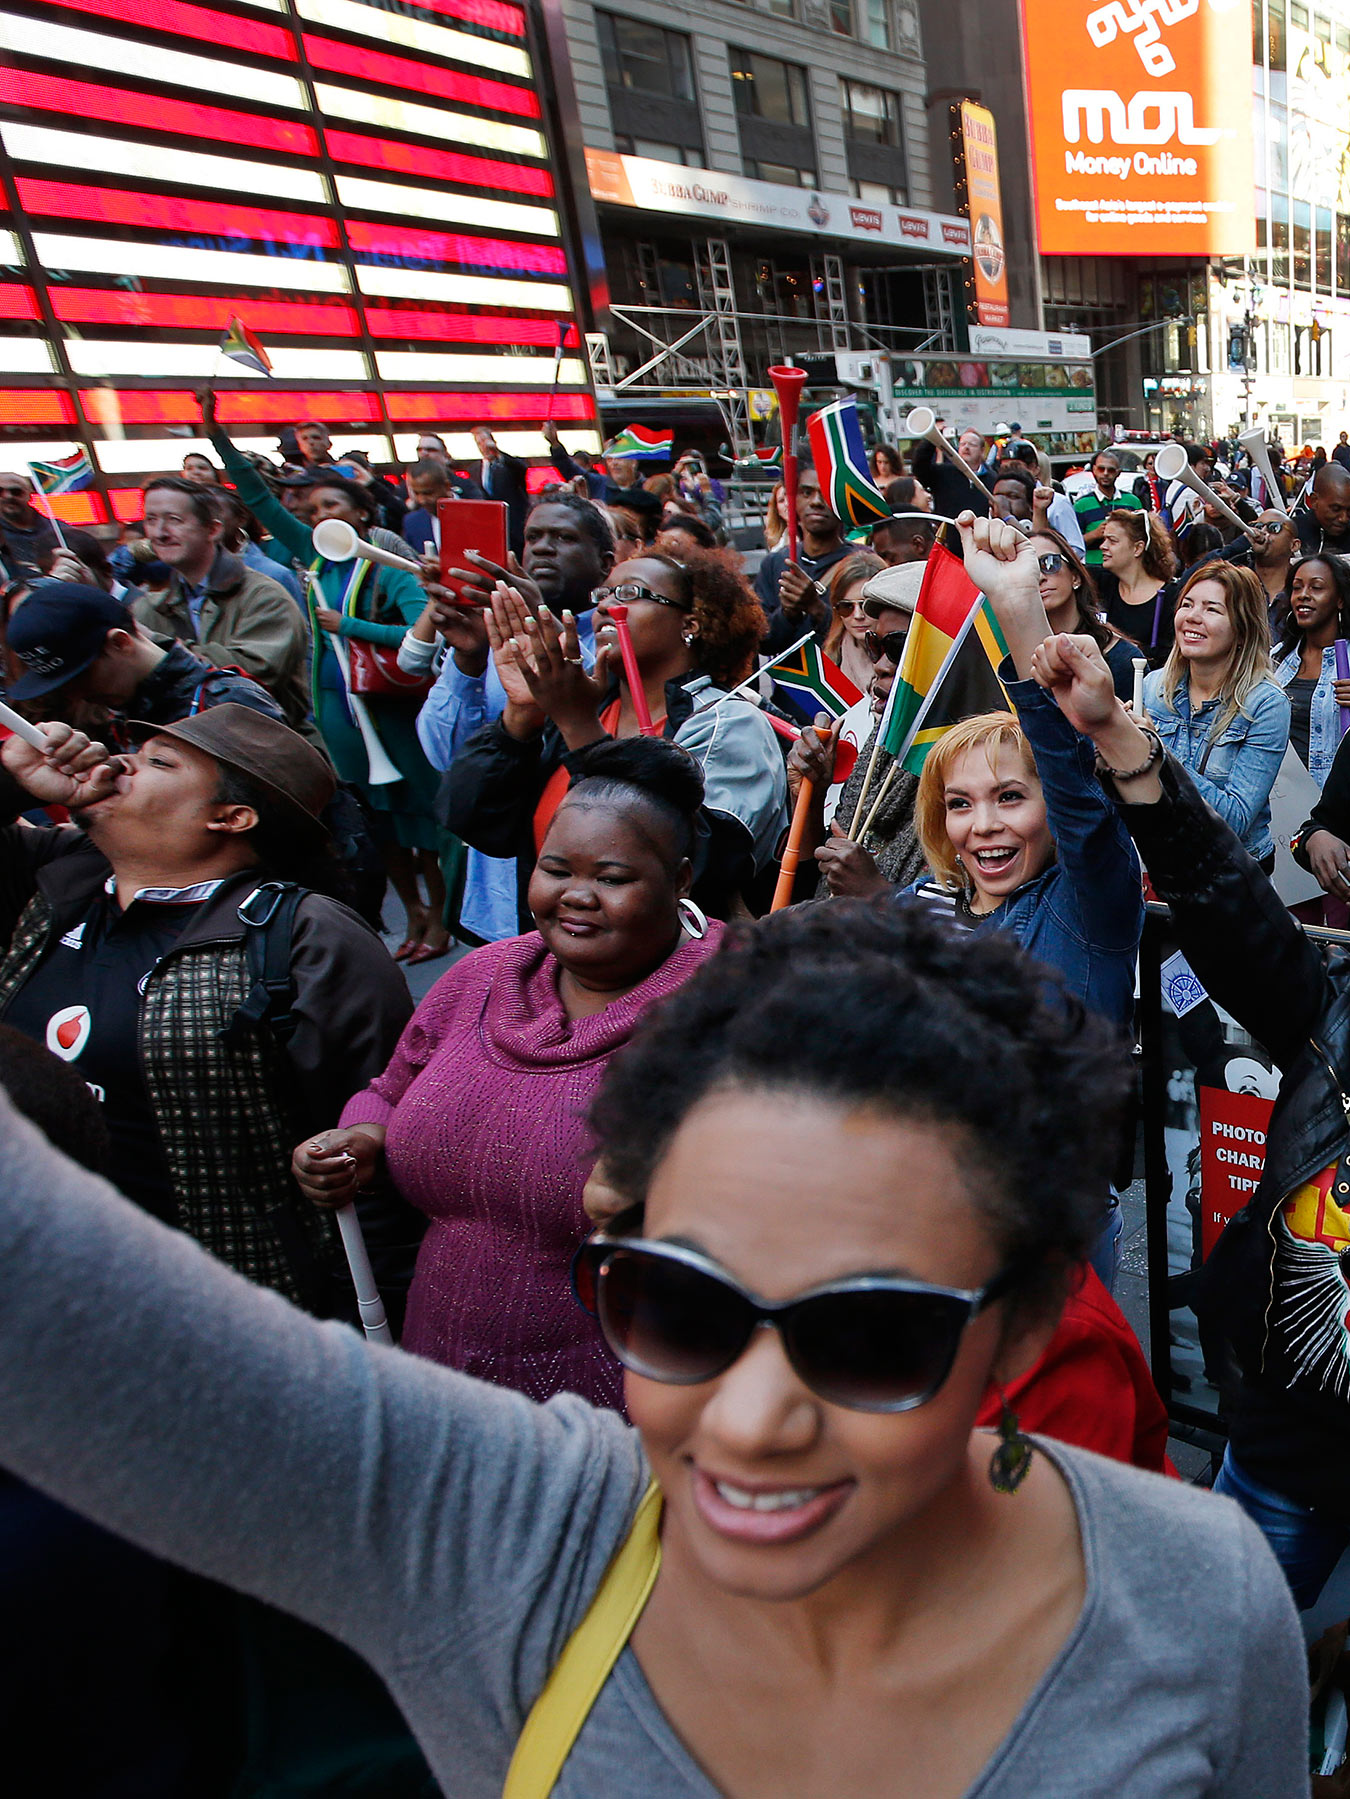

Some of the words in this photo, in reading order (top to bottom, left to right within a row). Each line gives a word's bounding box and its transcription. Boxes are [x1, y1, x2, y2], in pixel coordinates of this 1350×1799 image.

[964, 113, 995, 146] BUBBA
[968, 144, 995, 173] GUMP
[1065, 150, 1131, 180] Money
[1134, 151, 1197, 176] Online
[651, 178, 693, 200] BUBBA
[692, 183, 729, 206] GUMP
[894, 388, 924, 397] DISCOVER
[924, 389, 936, 397] THE
[936, 389, 968, 397] DIFFERENCE
[976, 389, 1012, 397] DISTRIBUTION
[1212, 1121, 1267, 1146] PHOTO
[1213, 1212, 1222, 1223] If
